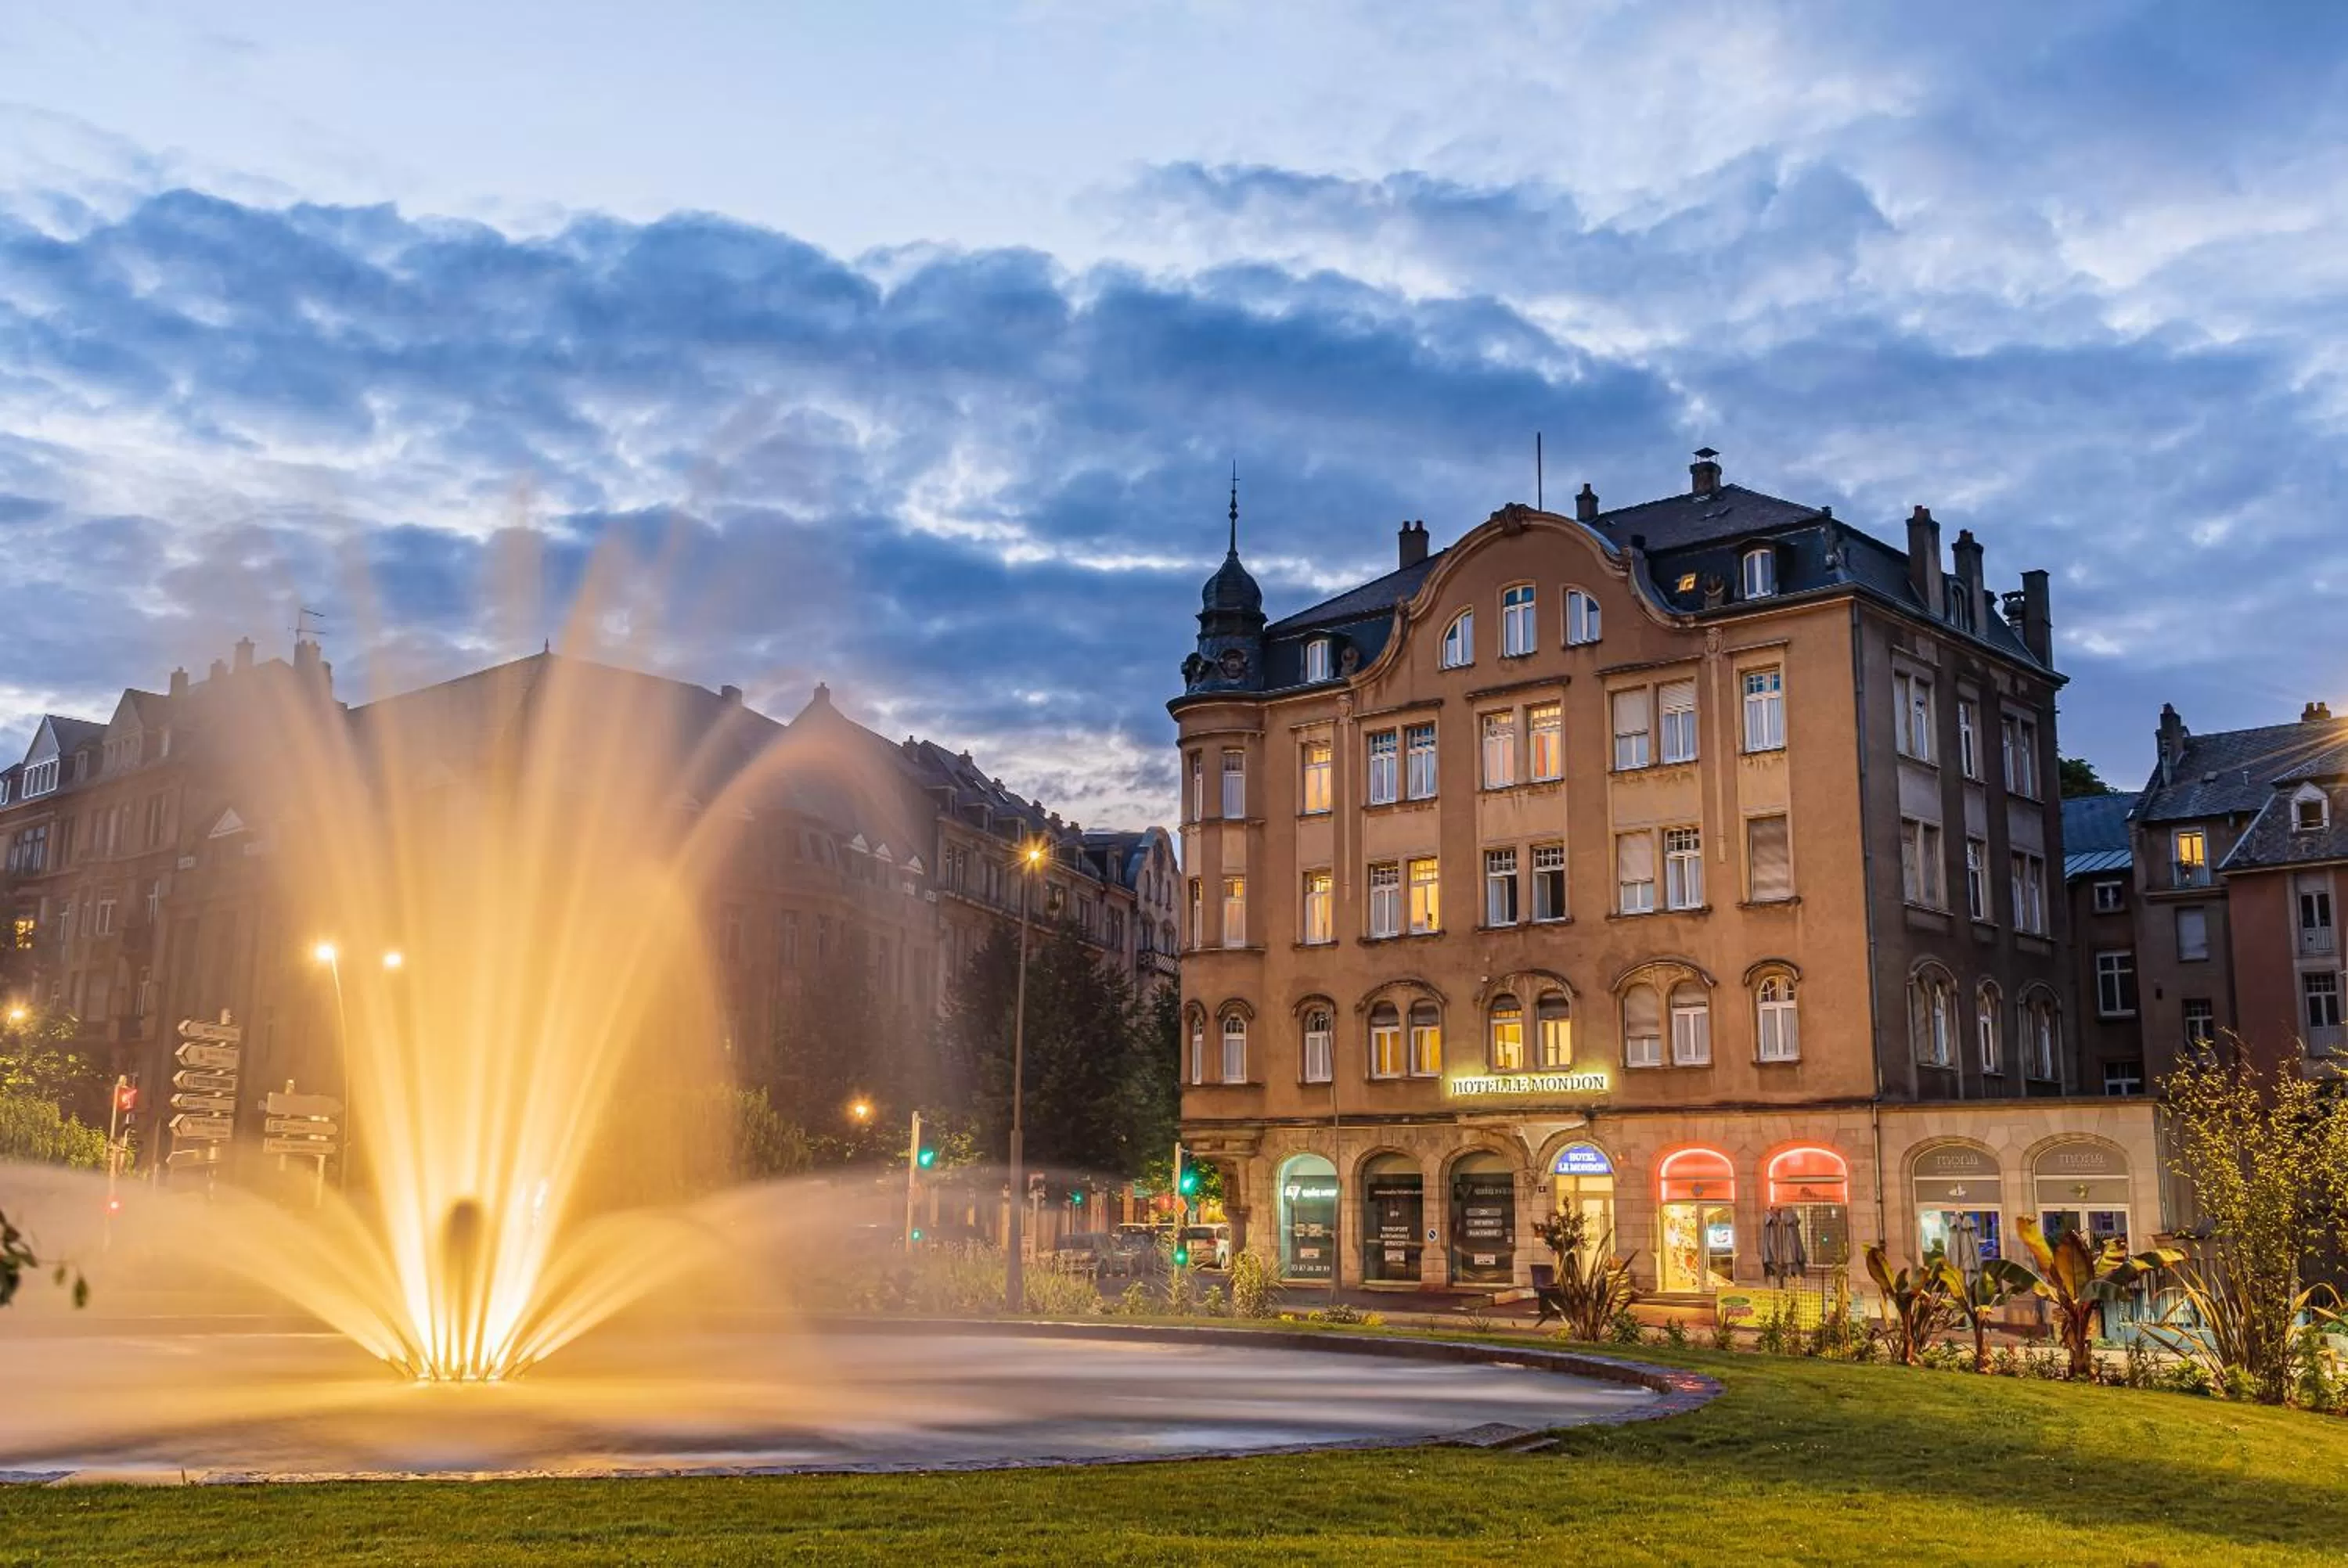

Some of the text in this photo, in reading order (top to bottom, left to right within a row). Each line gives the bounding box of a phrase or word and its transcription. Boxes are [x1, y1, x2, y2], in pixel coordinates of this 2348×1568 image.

[1453, 1076, 1604, 1093] HOTEL LE MONDON
